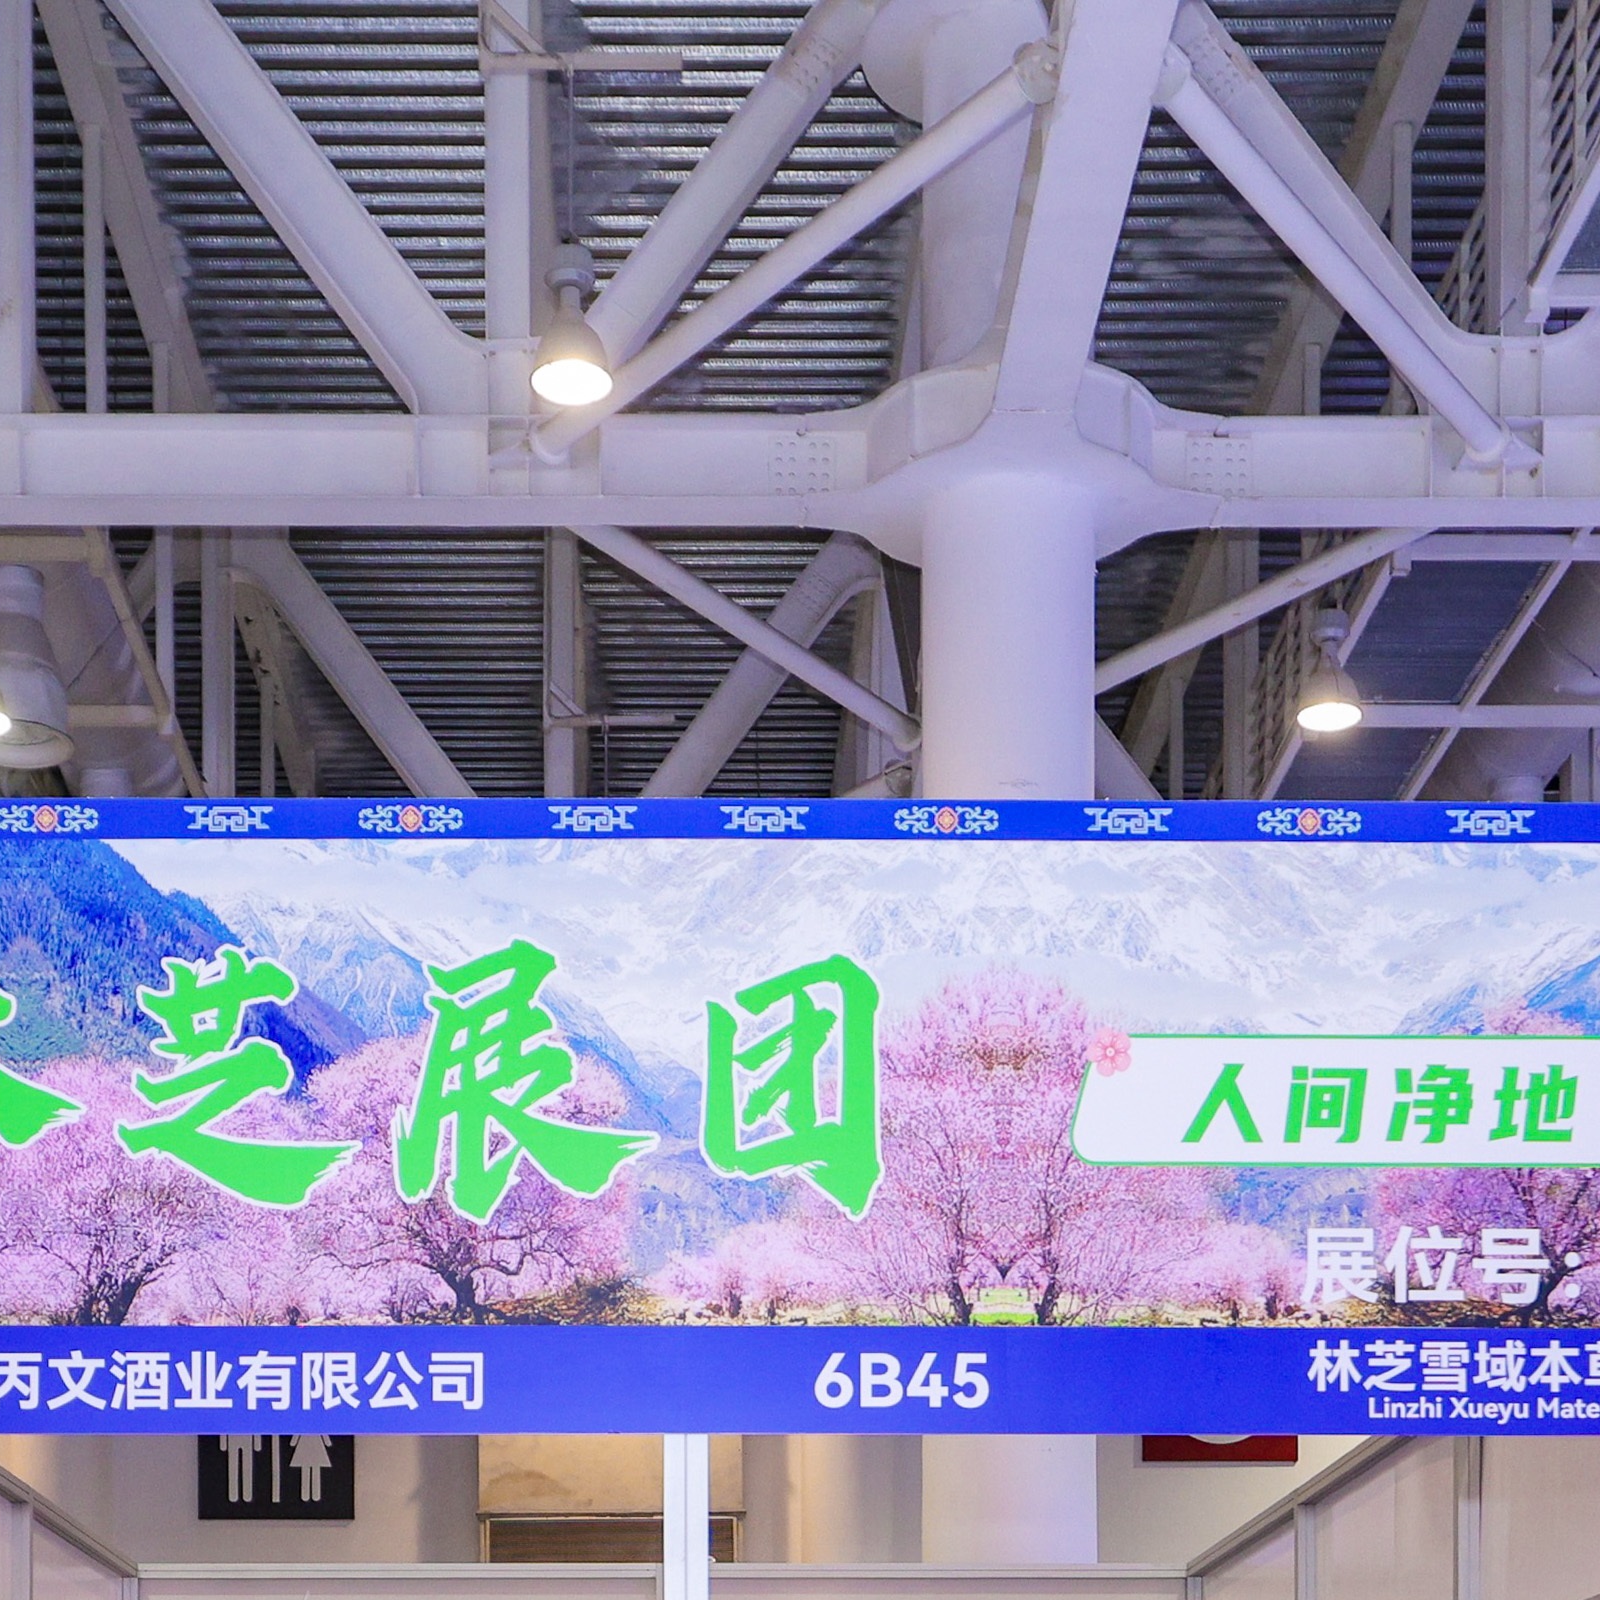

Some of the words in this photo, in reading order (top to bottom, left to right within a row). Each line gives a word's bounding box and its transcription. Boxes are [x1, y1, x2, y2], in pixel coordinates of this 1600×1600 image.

[1180, 1063, 1577, 1146] 人间净地
[812, 1352, 990, 1409] 6B45
[1368, 1396, 1443, 1419] Linzhi
[1448, 1397, 1530, 1425] Xueyu
